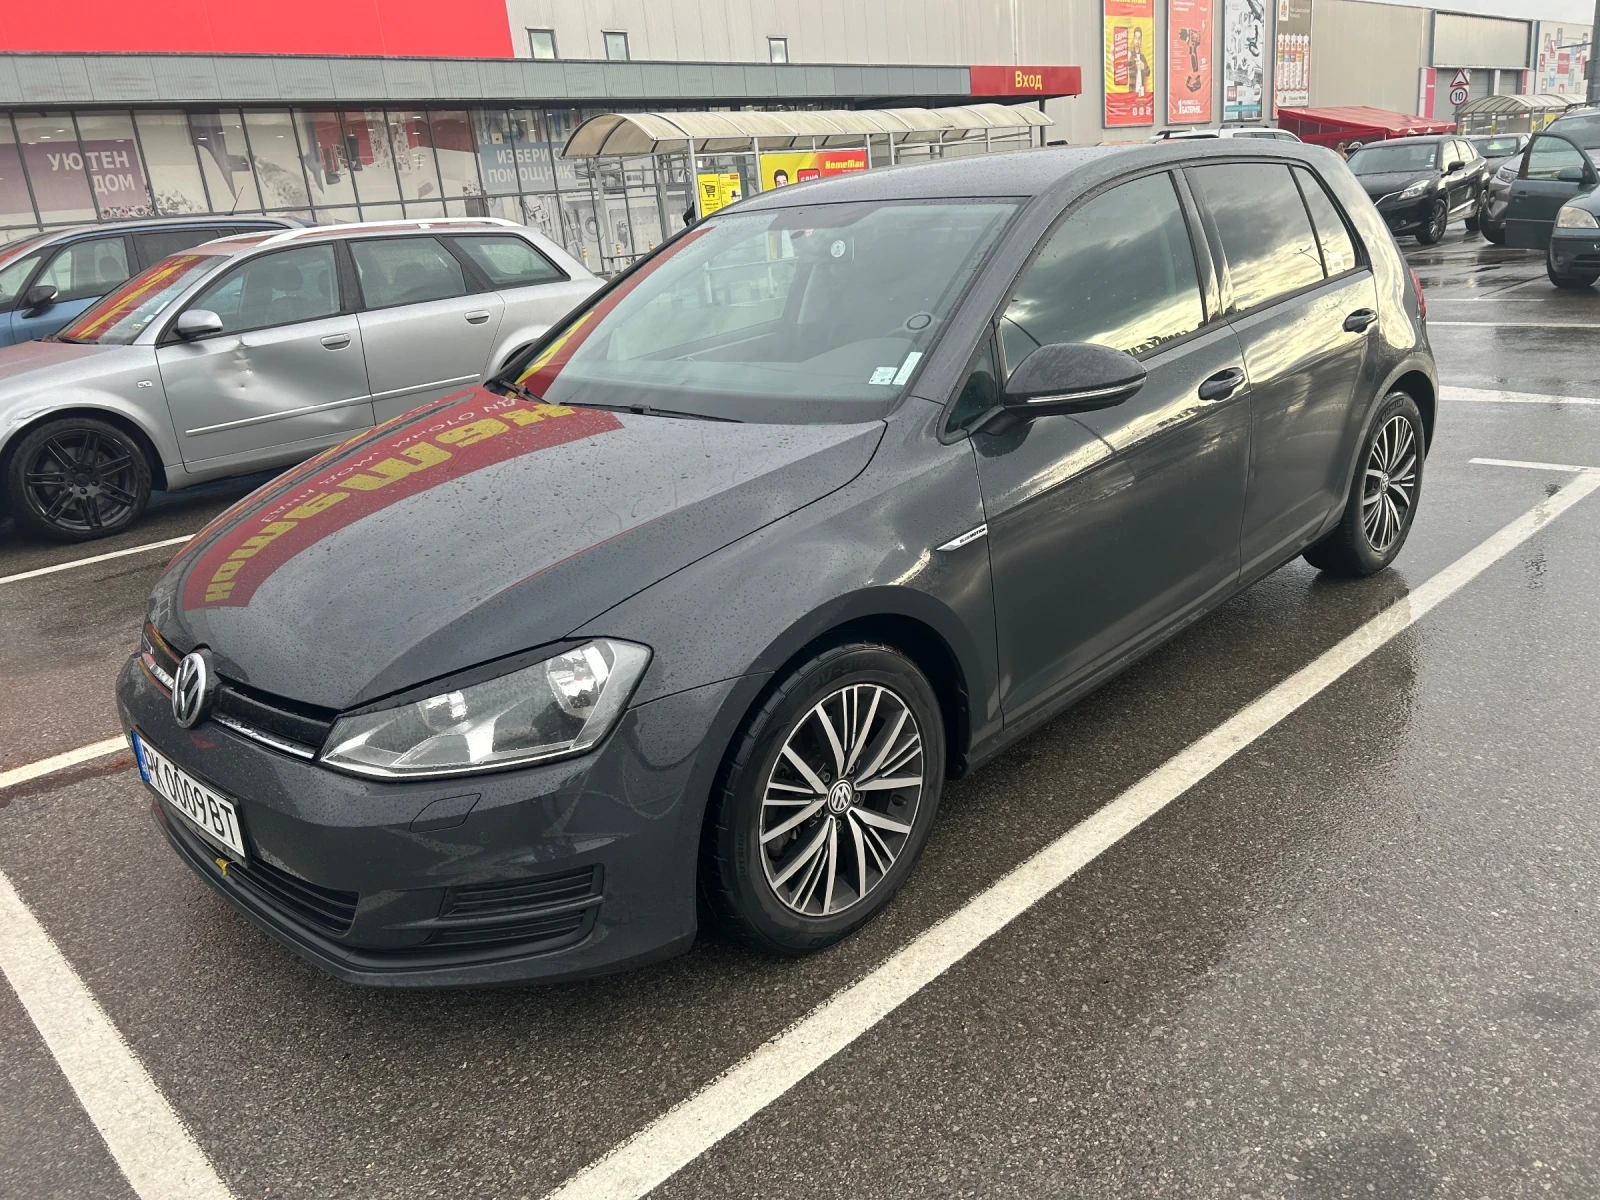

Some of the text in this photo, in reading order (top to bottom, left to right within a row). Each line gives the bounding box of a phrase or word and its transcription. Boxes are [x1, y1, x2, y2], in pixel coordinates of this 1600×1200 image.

[1015, 70, 1042, 90] Вход
[1454, 91, 1464, 101] 10
[47, 150, 130, 171] УЮТЕН
[496, 148, 550, 164] ИЗБЕРИ
[825, 159, 865, 169] HomeMax
[487, 165, 573, 183] ПОМОЩНИК
[93, 173, 136, 196] ДОМ
